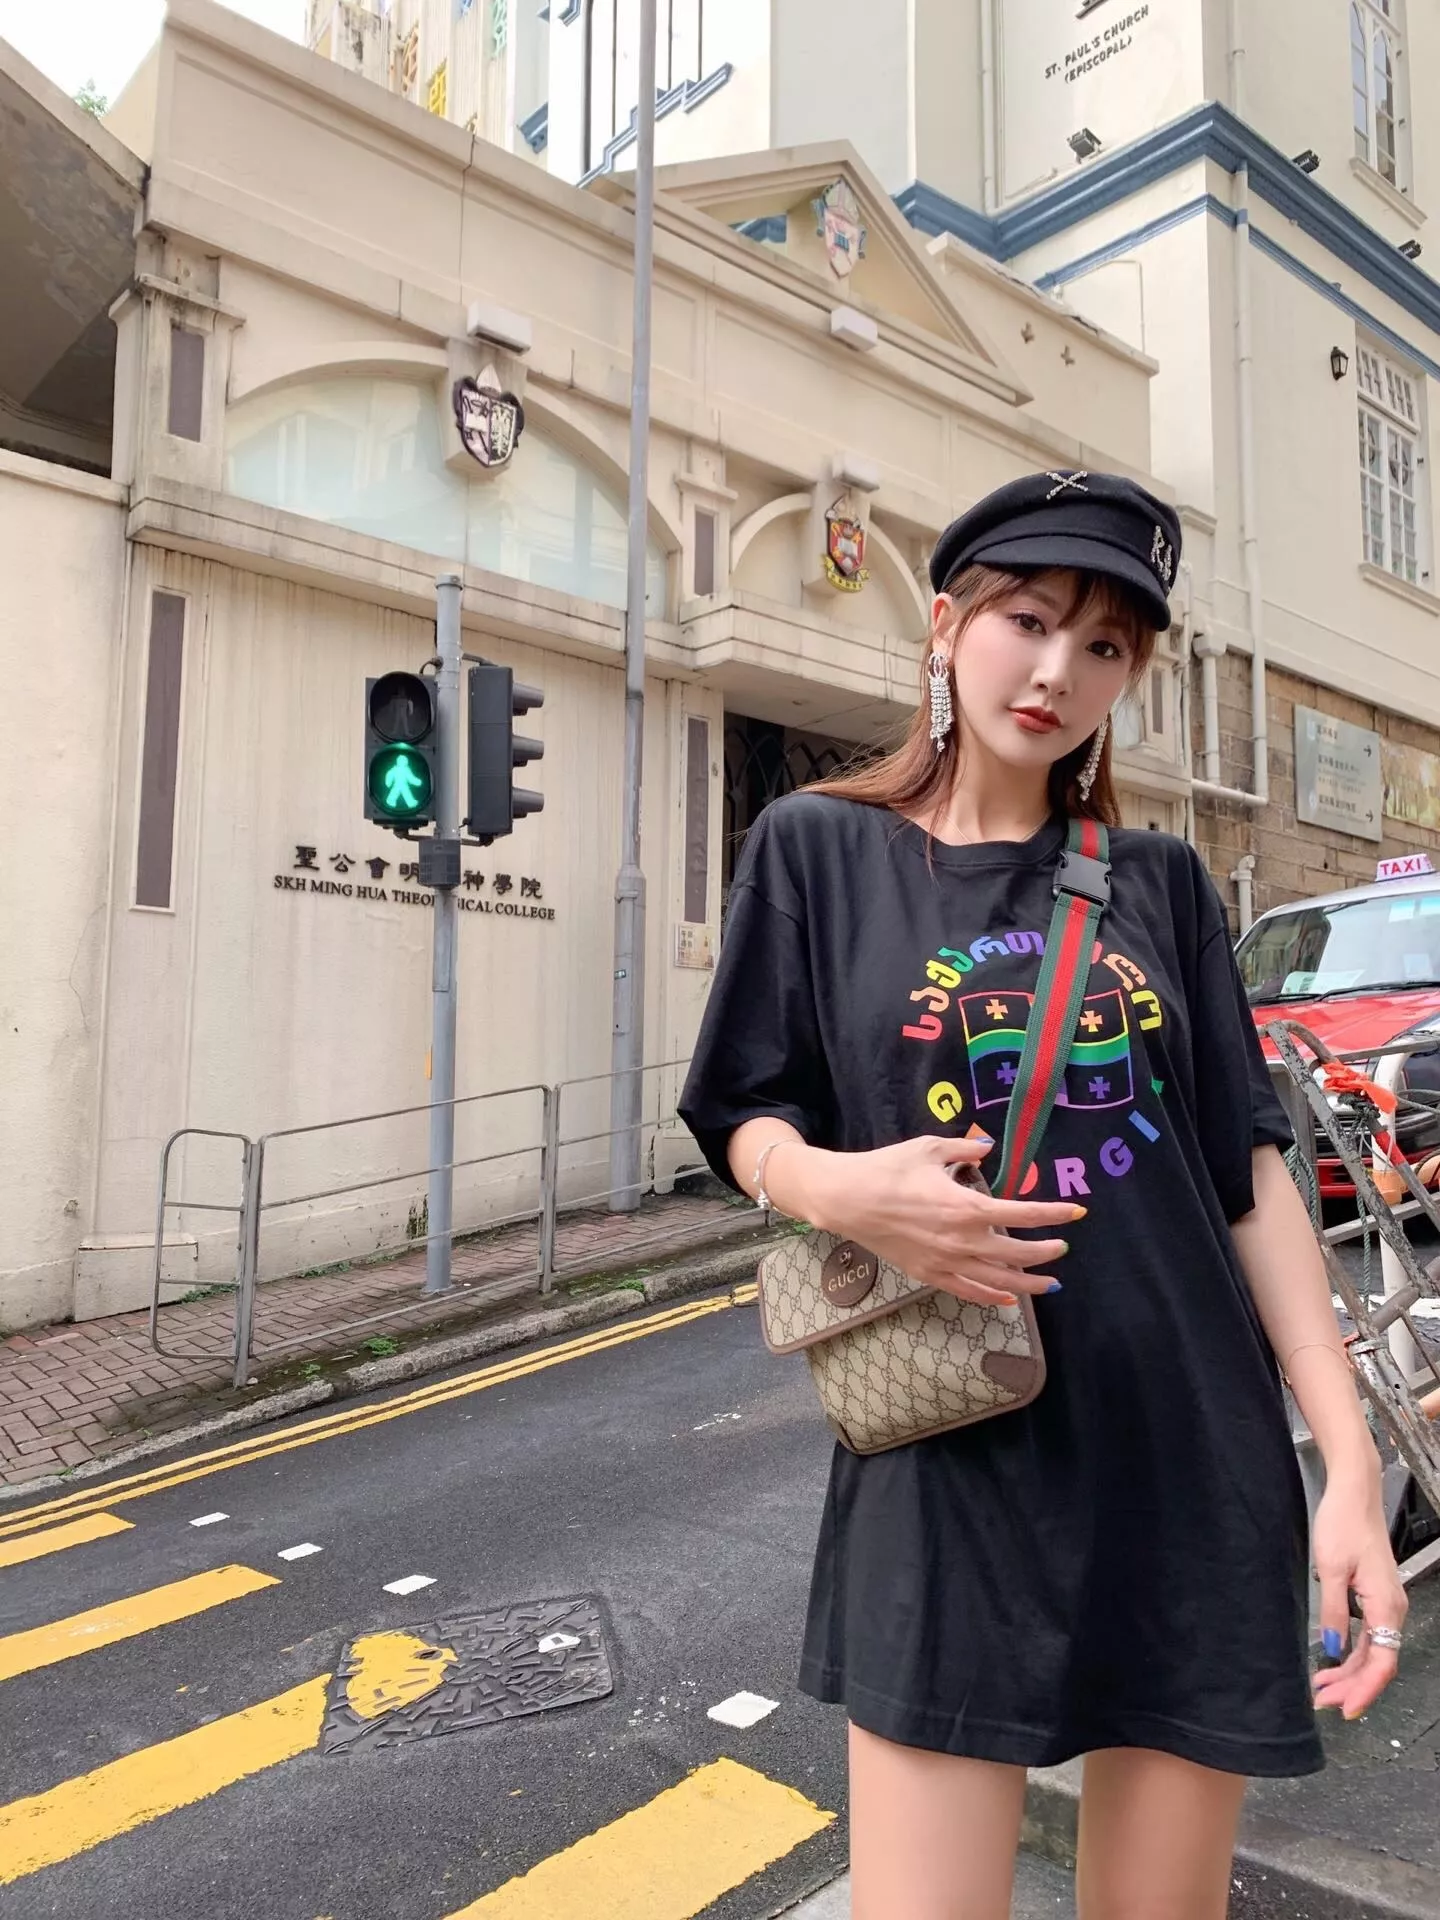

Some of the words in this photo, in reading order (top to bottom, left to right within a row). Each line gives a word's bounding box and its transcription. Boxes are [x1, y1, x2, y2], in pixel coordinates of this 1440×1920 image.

[1044, 62, 1062, 79] ST.
[1065, 36, 1101, 67] PAUL'S
[1103, 4, 1150, 42] CHURCH
[1064, 35, 1133, 84] (EPISCOPAL)
[292, 844, 544, 900] 聖公會明神學院
[1379, 858, 1421, 876] TAXI
[273, 874, 307, 892] SKH
[310, 878, 353, 898] MING
[356, 884, 388, 901] HUA
[494, 902, 556, 921] COLLEGE
[827, 1262, 870, 1293] GUCCI
